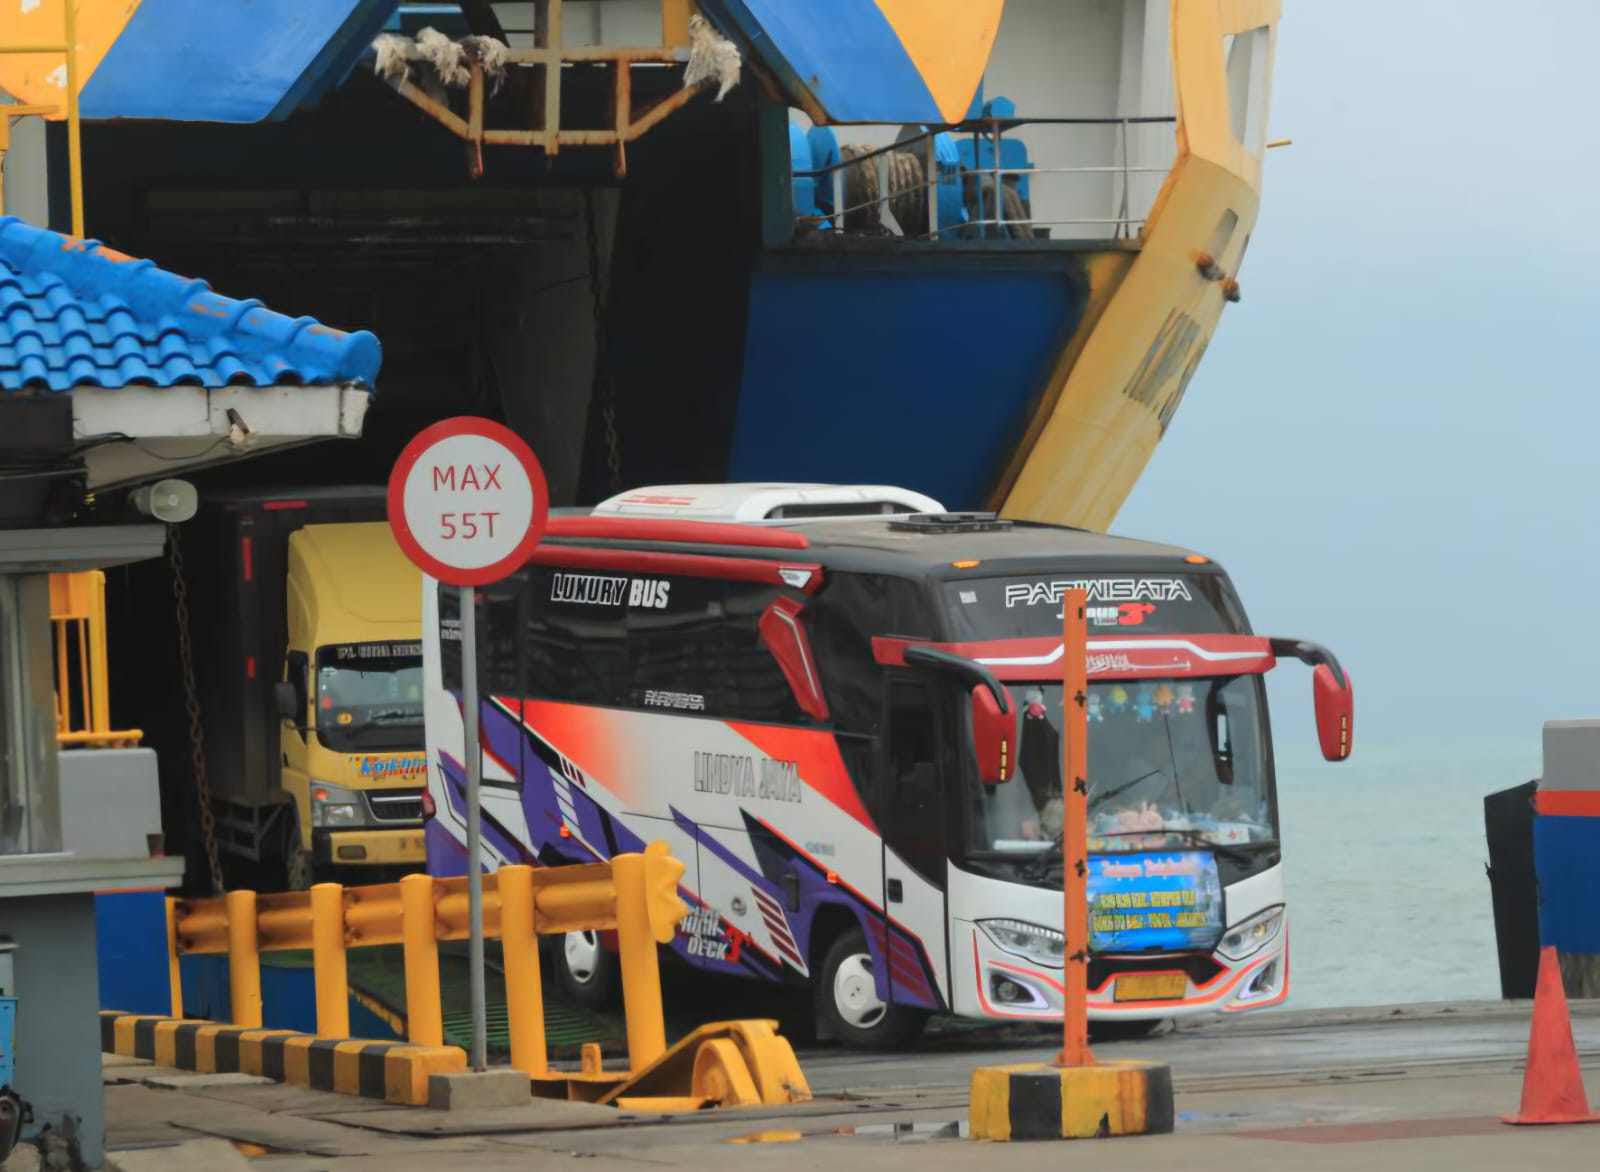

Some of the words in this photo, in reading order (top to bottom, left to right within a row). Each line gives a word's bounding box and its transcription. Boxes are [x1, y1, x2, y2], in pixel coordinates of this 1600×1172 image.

[433, 463, 502, 492] MAX
[441, 512, 501, 540] 55T
[551, 572, 628, 606] LUXURY
[628, 579, 671, 609] BUS
[694, 751, 756, 798] LINDYA
[687, 935, 729, 961] DECK
